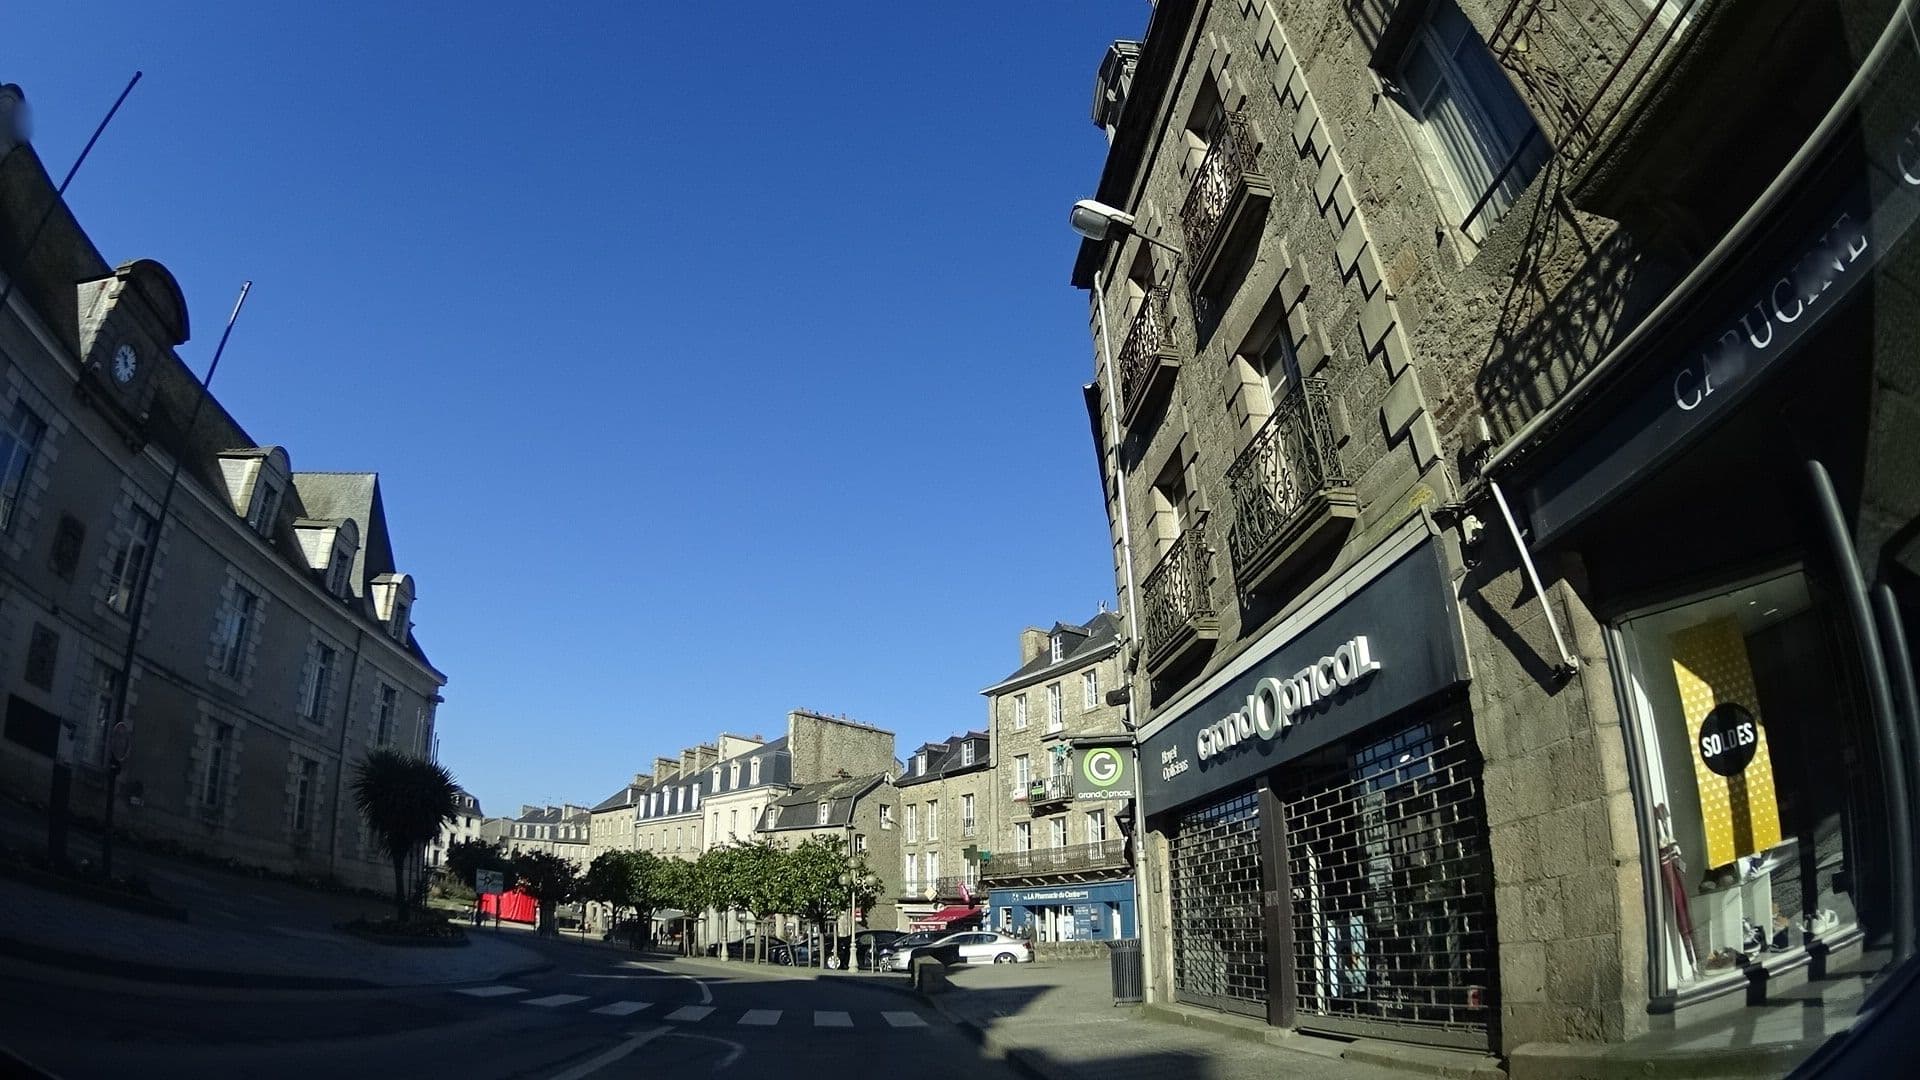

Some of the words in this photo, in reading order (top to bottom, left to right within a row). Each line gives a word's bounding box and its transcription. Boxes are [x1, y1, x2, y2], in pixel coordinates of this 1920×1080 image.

[1702, 722, 1754, 758] SOLDES
[1090, 752, 1117, 780] G
[1162, 759, 1189, 782] Opticiens
